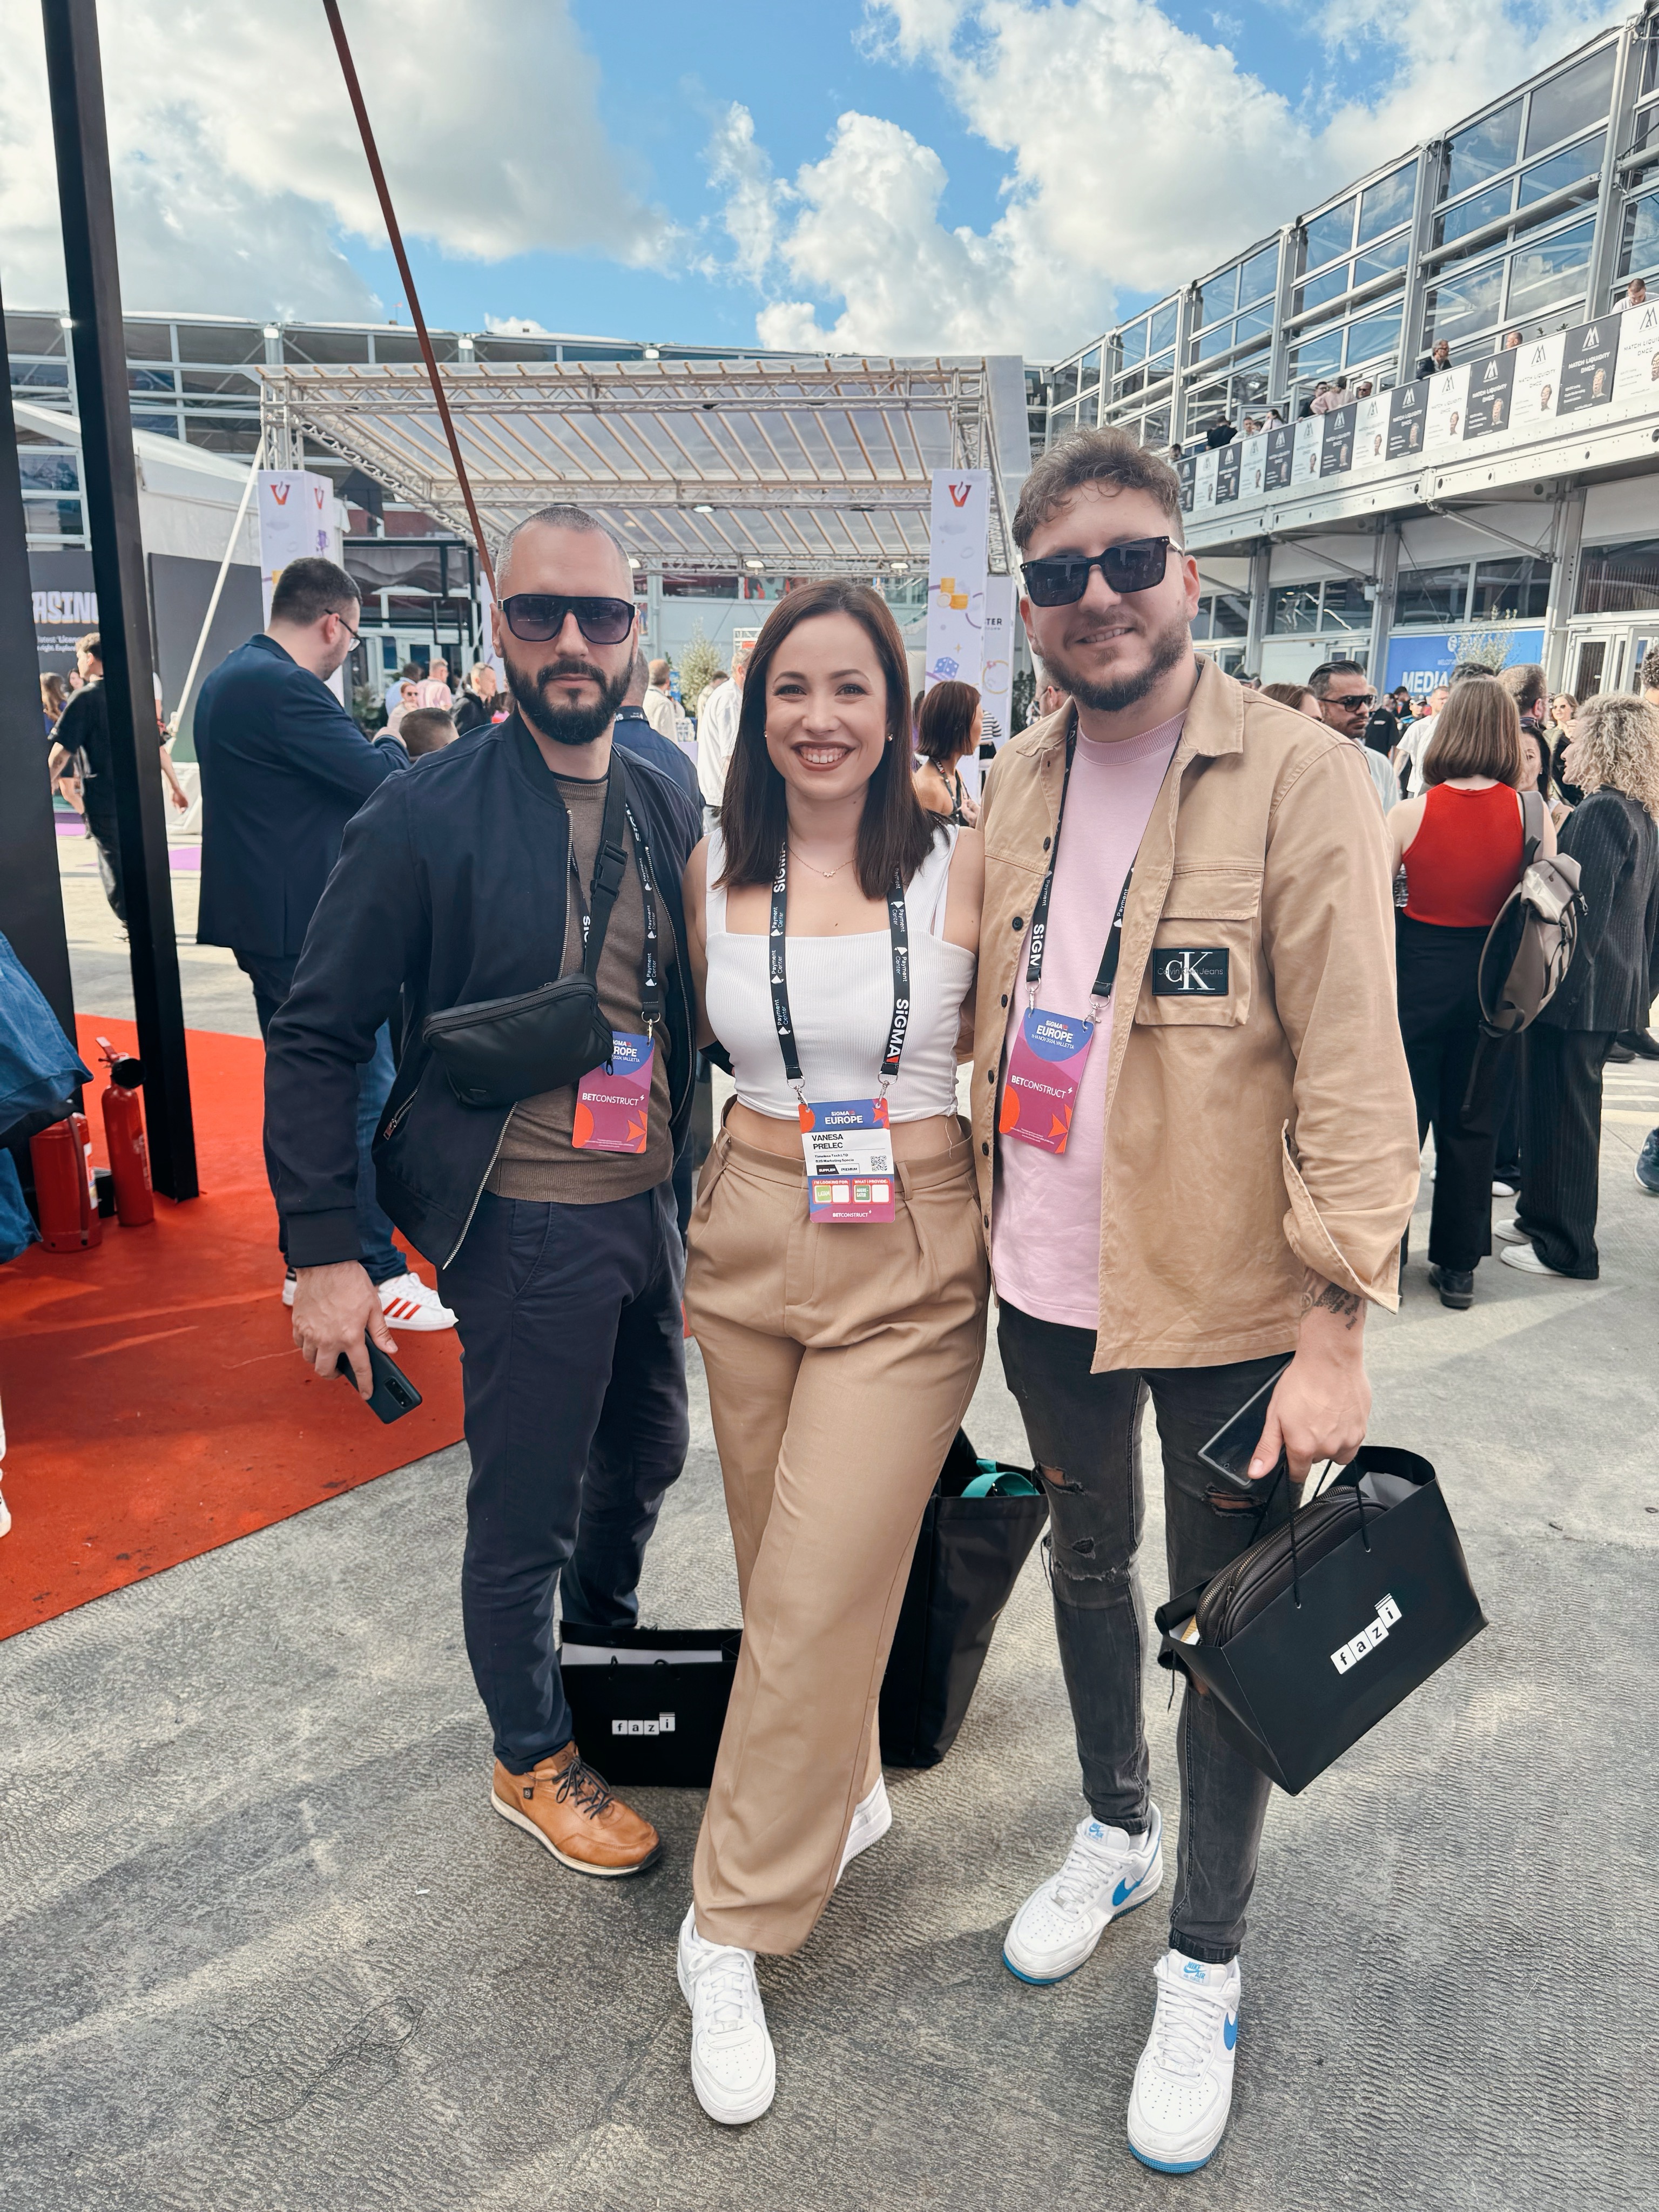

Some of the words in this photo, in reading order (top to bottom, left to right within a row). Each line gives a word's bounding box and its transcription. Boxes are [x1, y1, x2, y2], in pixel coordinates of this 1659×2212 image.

[1586, 351, 1610, 365] LIQUIDITY
[1402, 671, 1449, 693] MEDIA
[1199, 967, 1224, 975] Jeans
[774, 999, 783, 1026] Payment
[1036, 1024, 1074, 1043] EUROPE
[613, 1046, 637, 1057] ROPE
[1056, 1040, 1074, 1050] VALLETTA
[1011, 1075, 1067, 1099] BETCONSTRUCT
[582, 1092, 638, 1106] BETCONSTRUCT
[825, 1115, 864, 1125] EUROPE
[1337, 1602, 1397, 1669] fazi
[615, 1717, 673, 1734] fazi
